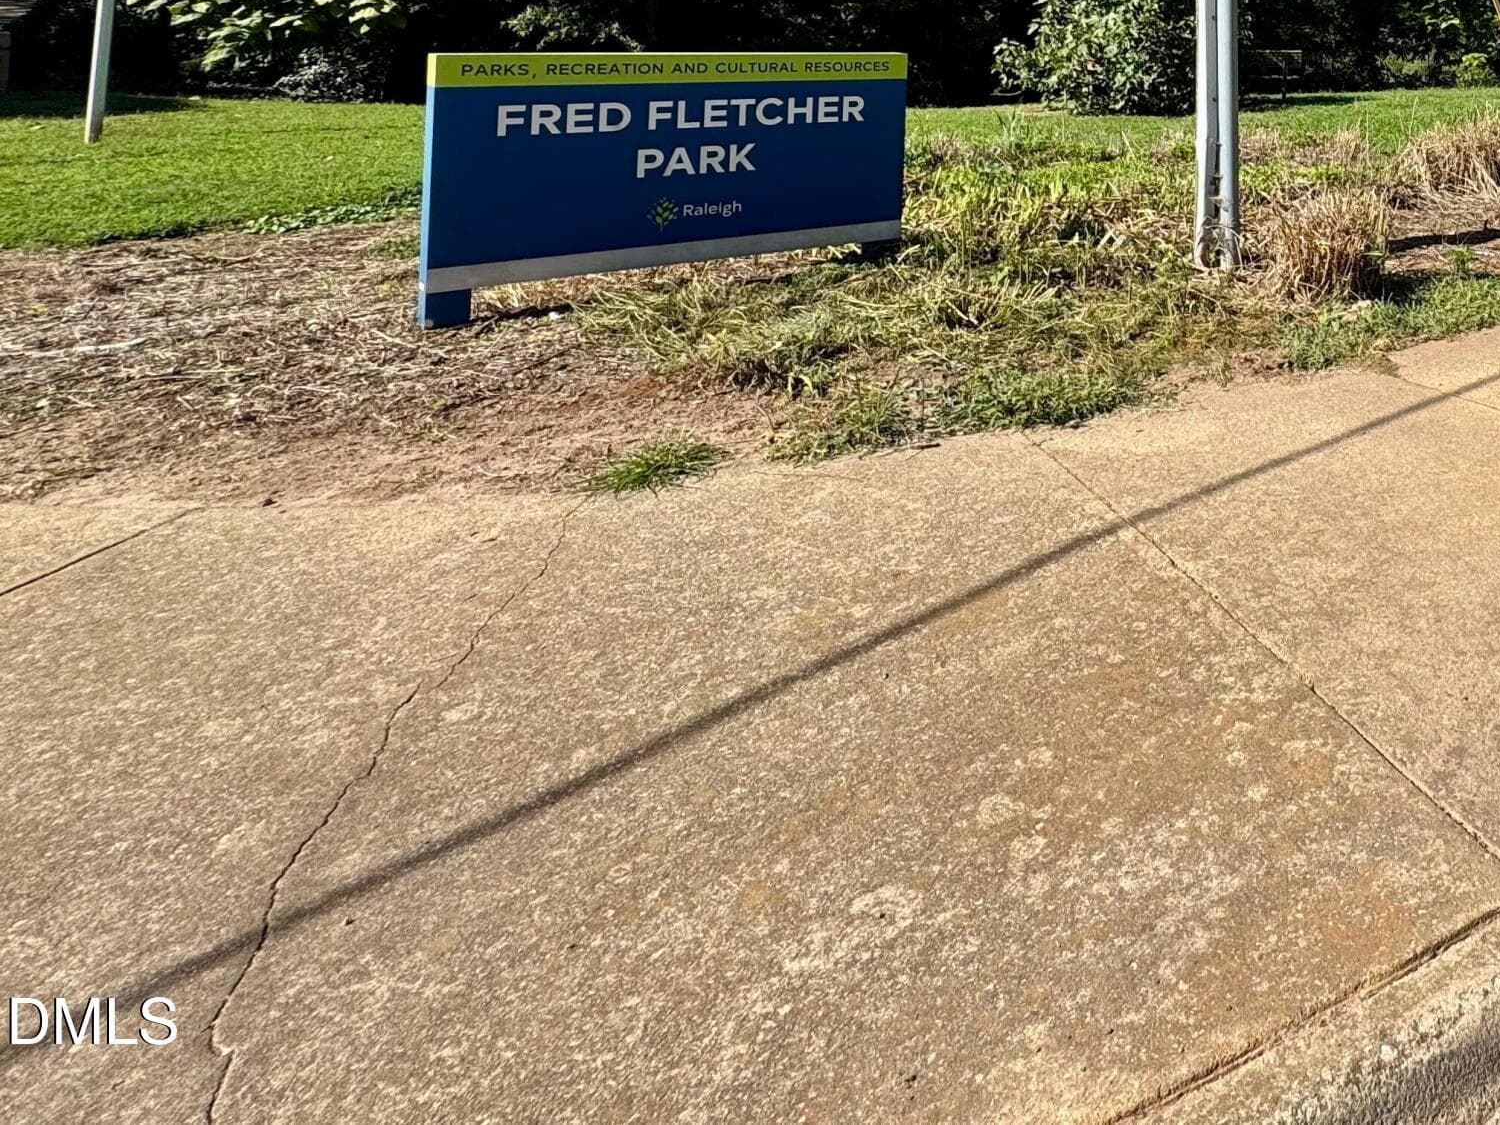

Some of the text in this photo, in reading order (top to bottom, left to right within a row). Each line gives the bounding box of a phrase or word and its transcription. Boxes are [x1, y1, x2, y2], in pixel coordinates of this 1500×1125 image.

[461, 61, 890, 79] PARKS, RECREATION AND CULTURAL RESOURCES
[496, 95, 865, 137] FRED FLETCHER
[636, 143, 756, 179] PARK
[682, 200, 742, 217] Raleigh
